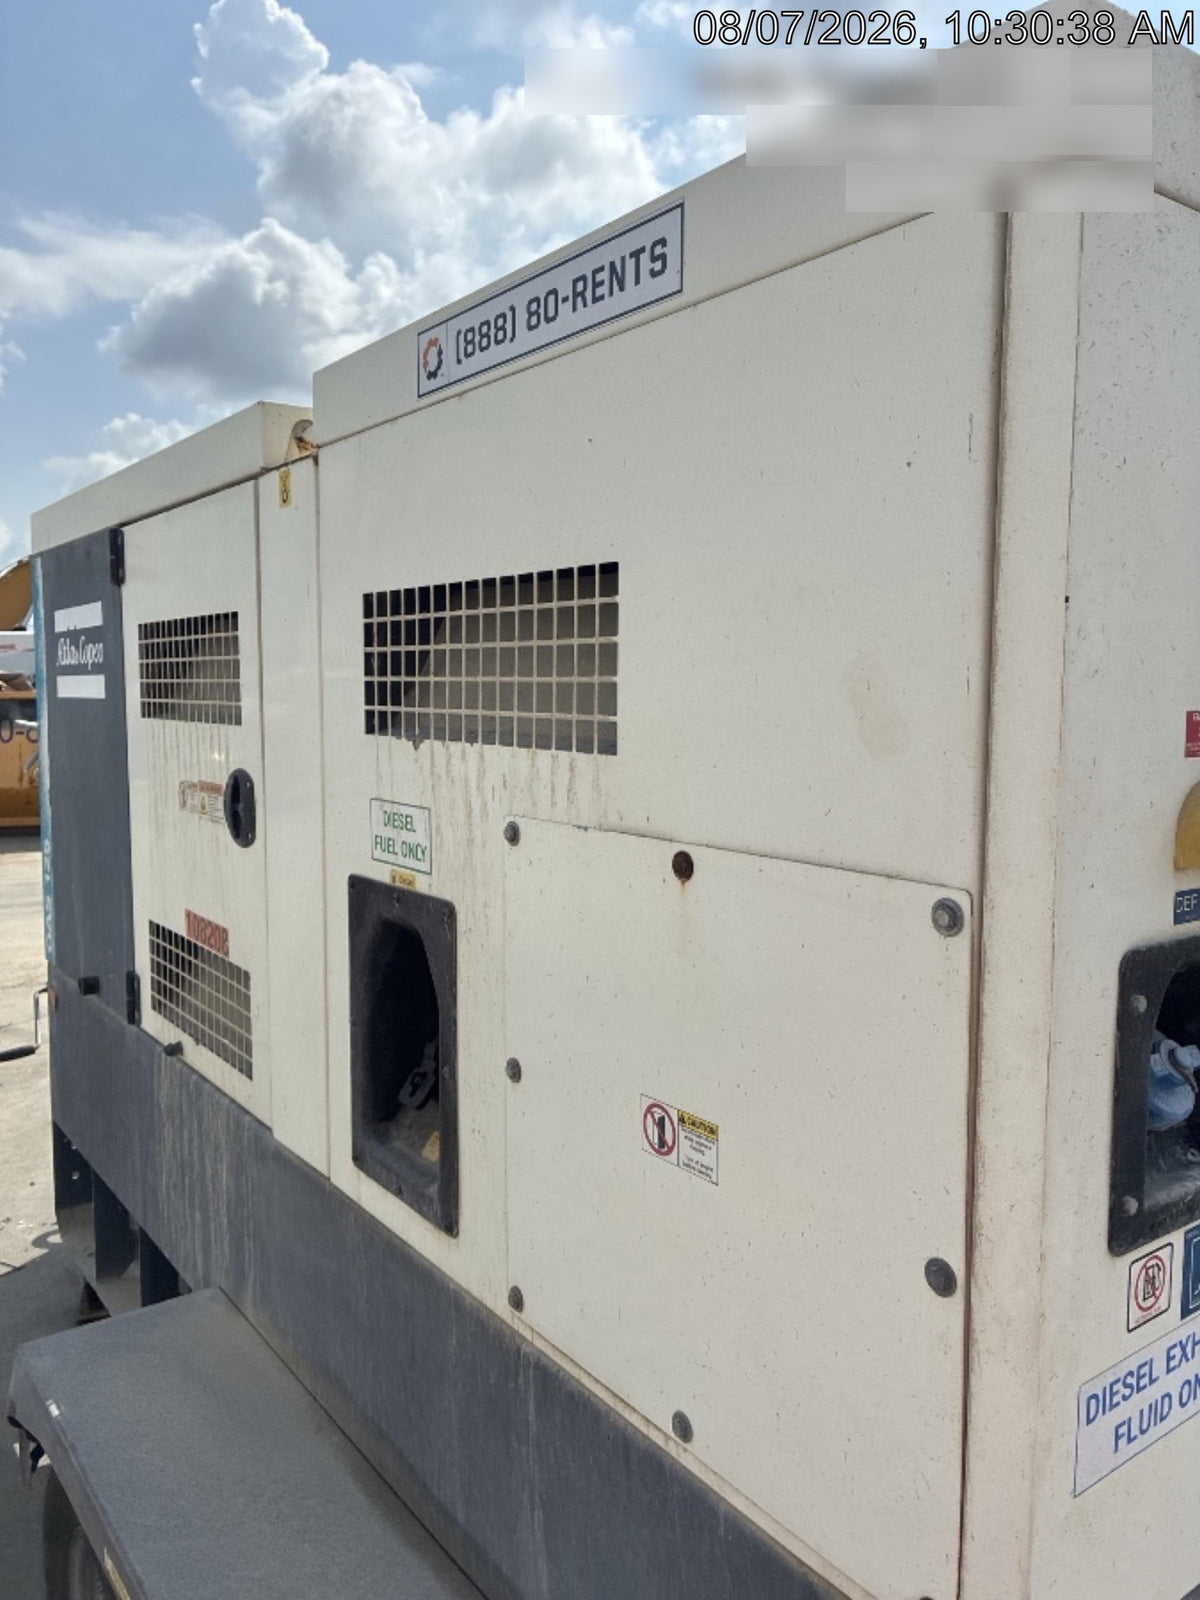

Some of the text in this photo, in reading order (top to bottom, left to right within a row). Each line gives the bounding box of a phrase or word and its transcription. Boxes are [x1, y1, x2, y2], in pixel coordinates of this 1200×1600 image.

[456, 236, 668, 365] (888) 80-RENTS
[56, 635, 104, 671] Atlas Copco
[383, 810, 416, 833] DIESEL
[374, 834, 427, 862] FUEL ONLY
[1086, 1358, 1160, 1426] DIESEL
[1114, 1391, 1173, 1454] FLUID
